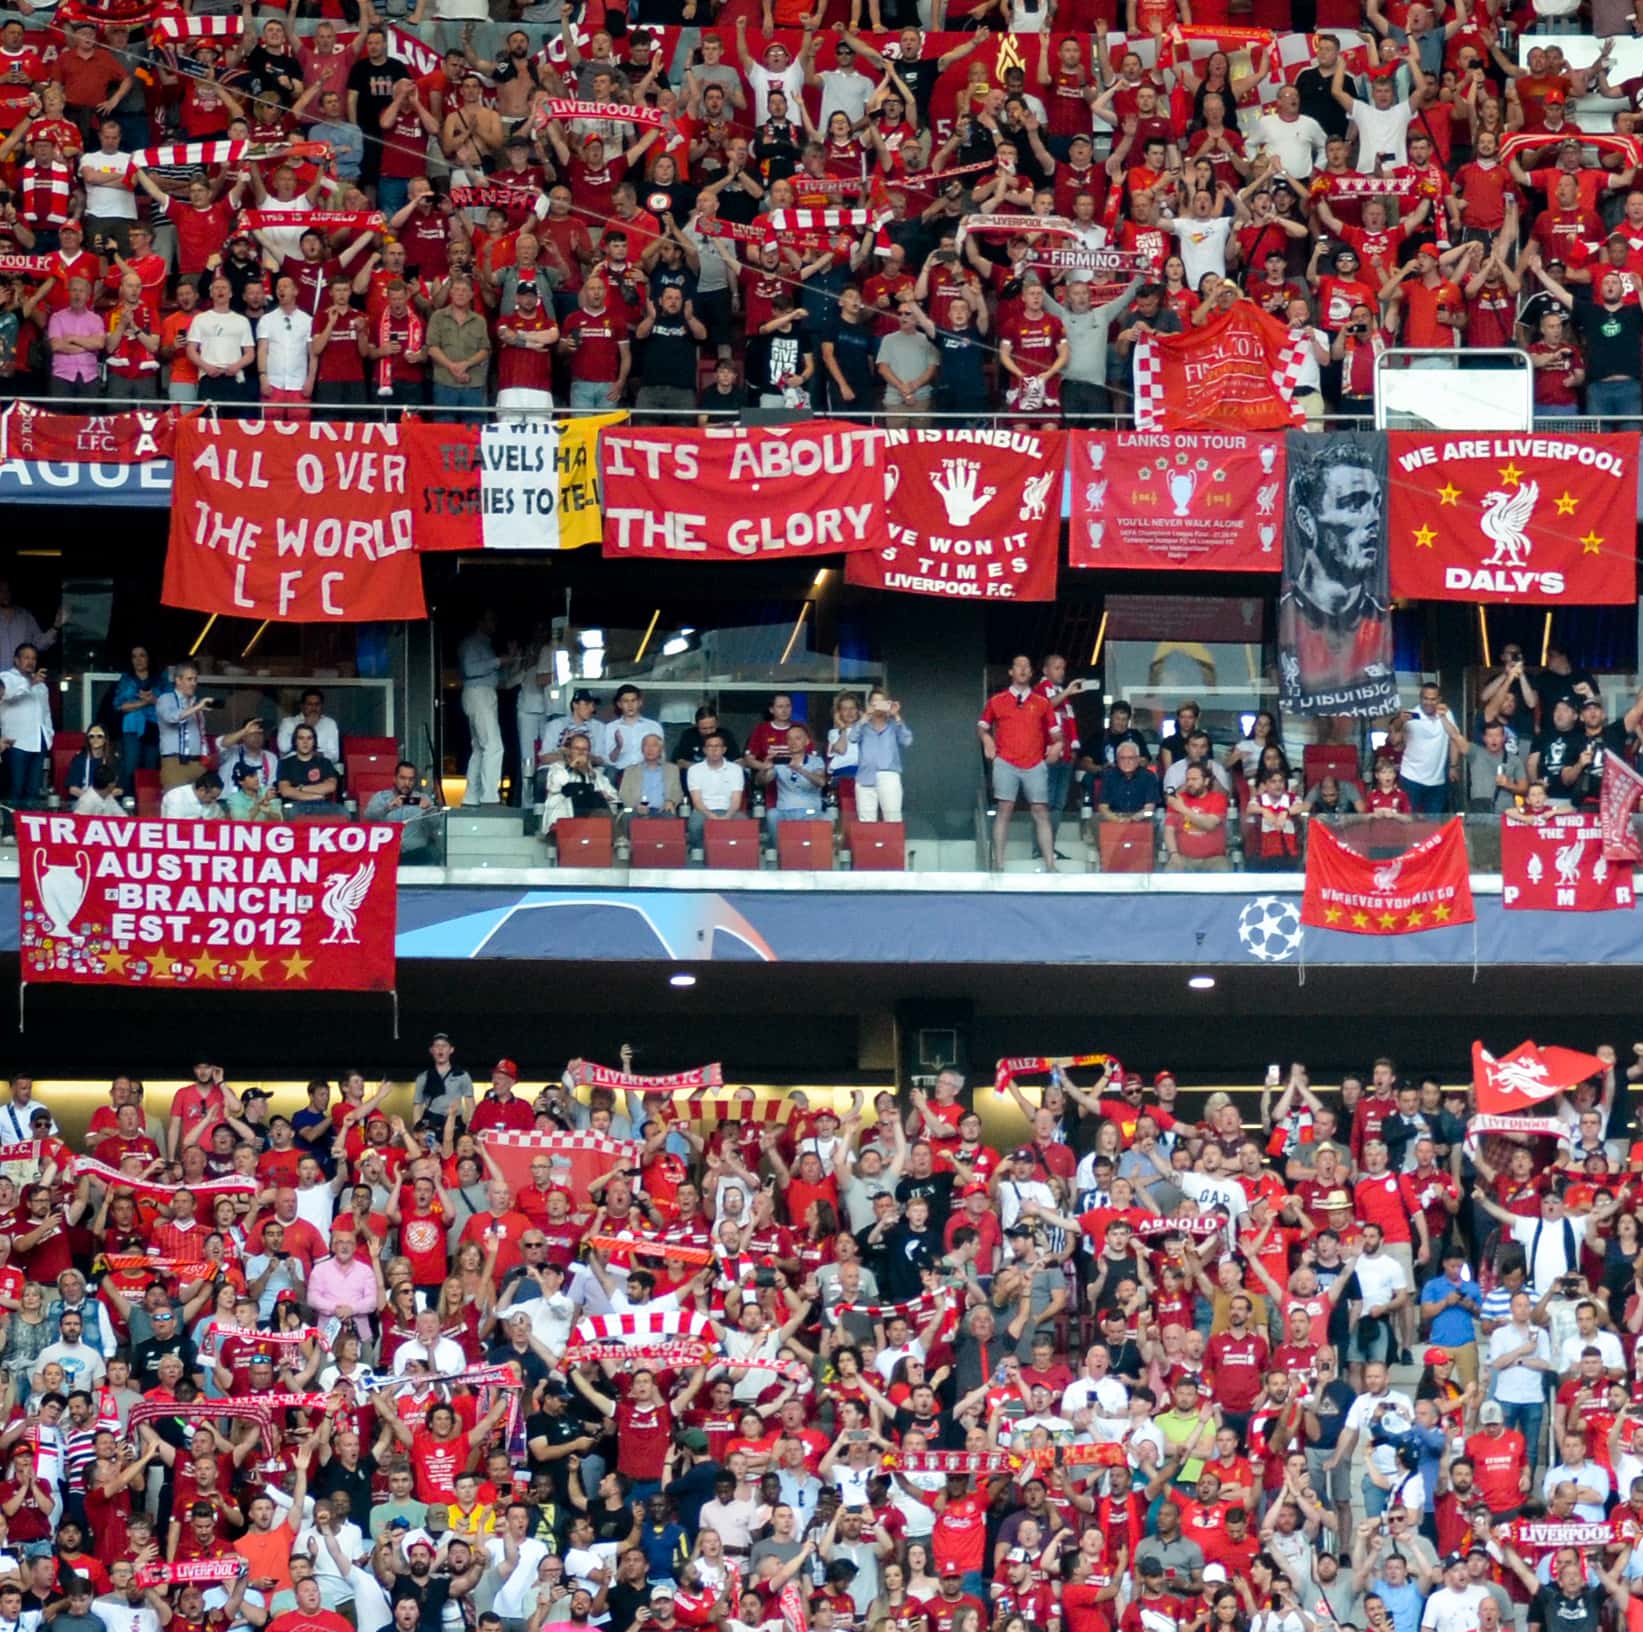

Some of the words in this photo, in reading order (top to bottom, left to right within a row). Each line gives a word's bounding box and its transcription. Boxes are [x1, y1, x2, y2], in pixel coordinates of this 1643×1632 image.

[551, 100, 638, 118] LIVERPOOL
[641, 109, 662, 122] FC
[1051, 249, 1120, 269] FIRMINO
[605, 437, 699, 481] ITS
[730, 429, 886, 481] ABOUT
[1117, 434, 1170, 450] LANKS
[1174, 434, 1199, 449] ON
[1201, 434, 1248, 450] TOUR
[194, 442, 269, 489] ALL
[296, 450, 406, 495] OVER
[1399, 446, 1436, 473] WE
[1443, 439, 1491, 462] ARE
[1494, 438, 1625, 479] LIVERPOOL
[194, 499, 258, 562] THE
[277, 508, 413, 562] WORLD
[606, 507, 707, 553] THE
[727, 503, 873, 555] GLORY
[885, 572, 981, 598] LIVERPOOL
[986, 578, 1017, 599] F.C.
[1445, 566, 1566, 595] DALY'S
[21, 815, 295, 855] TRAVELLING
[309, 826, 394, 853] KOP
[95, 852, 319, 884] AUSTRIAN
[118, 883, 297, 914] BRANCH
[596, 1068, 677, 1086] LIVERPOOL
[1139, 1216, 1217, 1231] ARNOLD
[1520, 1524, 1613, 1543] LIVERPOOL
[177, 1562, 235, 1579] LIVERPOOL
